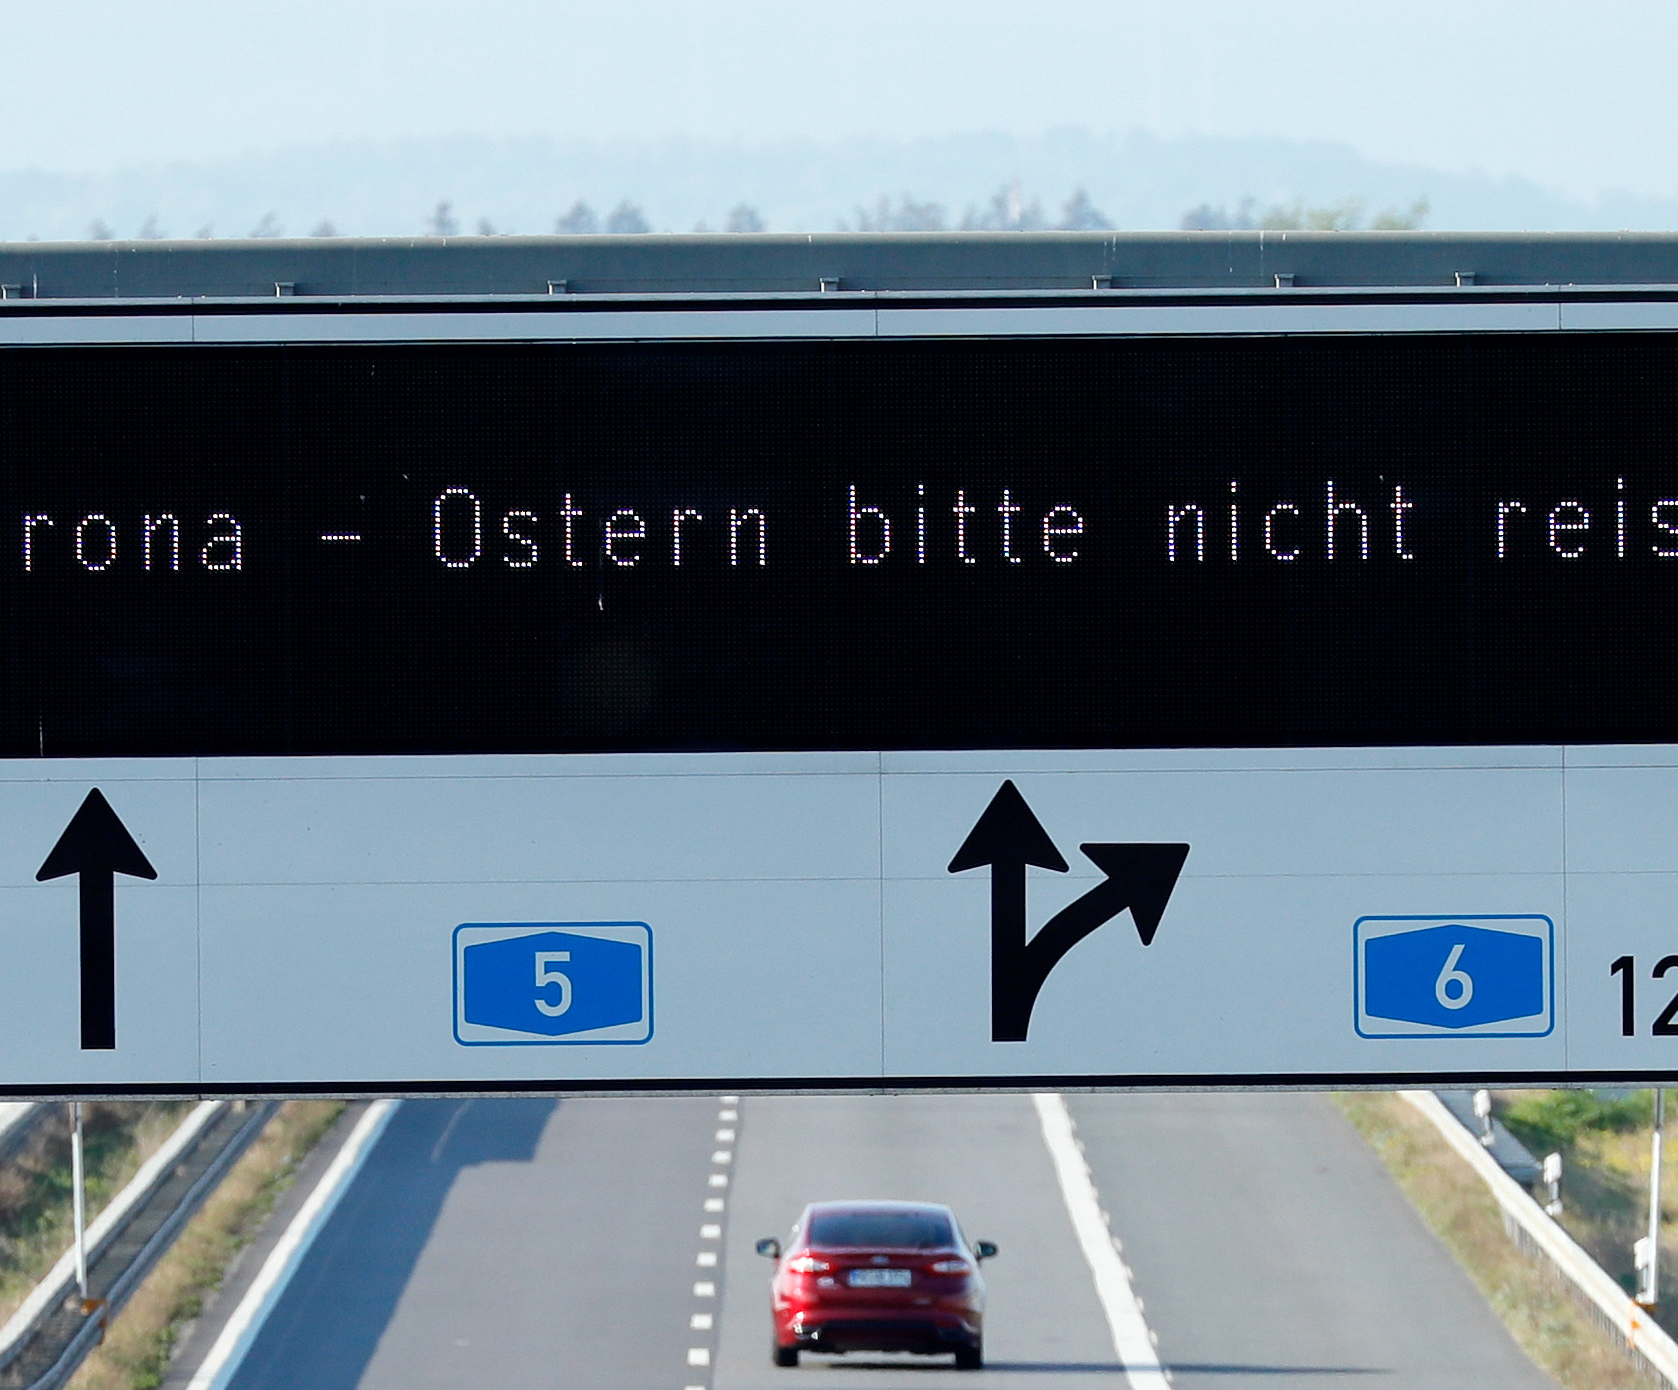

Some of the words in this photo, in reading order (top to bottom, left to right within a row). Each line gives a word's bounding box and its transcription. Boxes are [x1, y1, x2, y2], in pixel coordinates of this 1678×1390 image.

[432, 486, 768, 570] Ostern
[847, 482, 1086, 567] bitte
[1166, 479, 1416, 564] nicht
[533, 950, 573, 1018] 5
[1434, 943, 1474, 1011] 6
